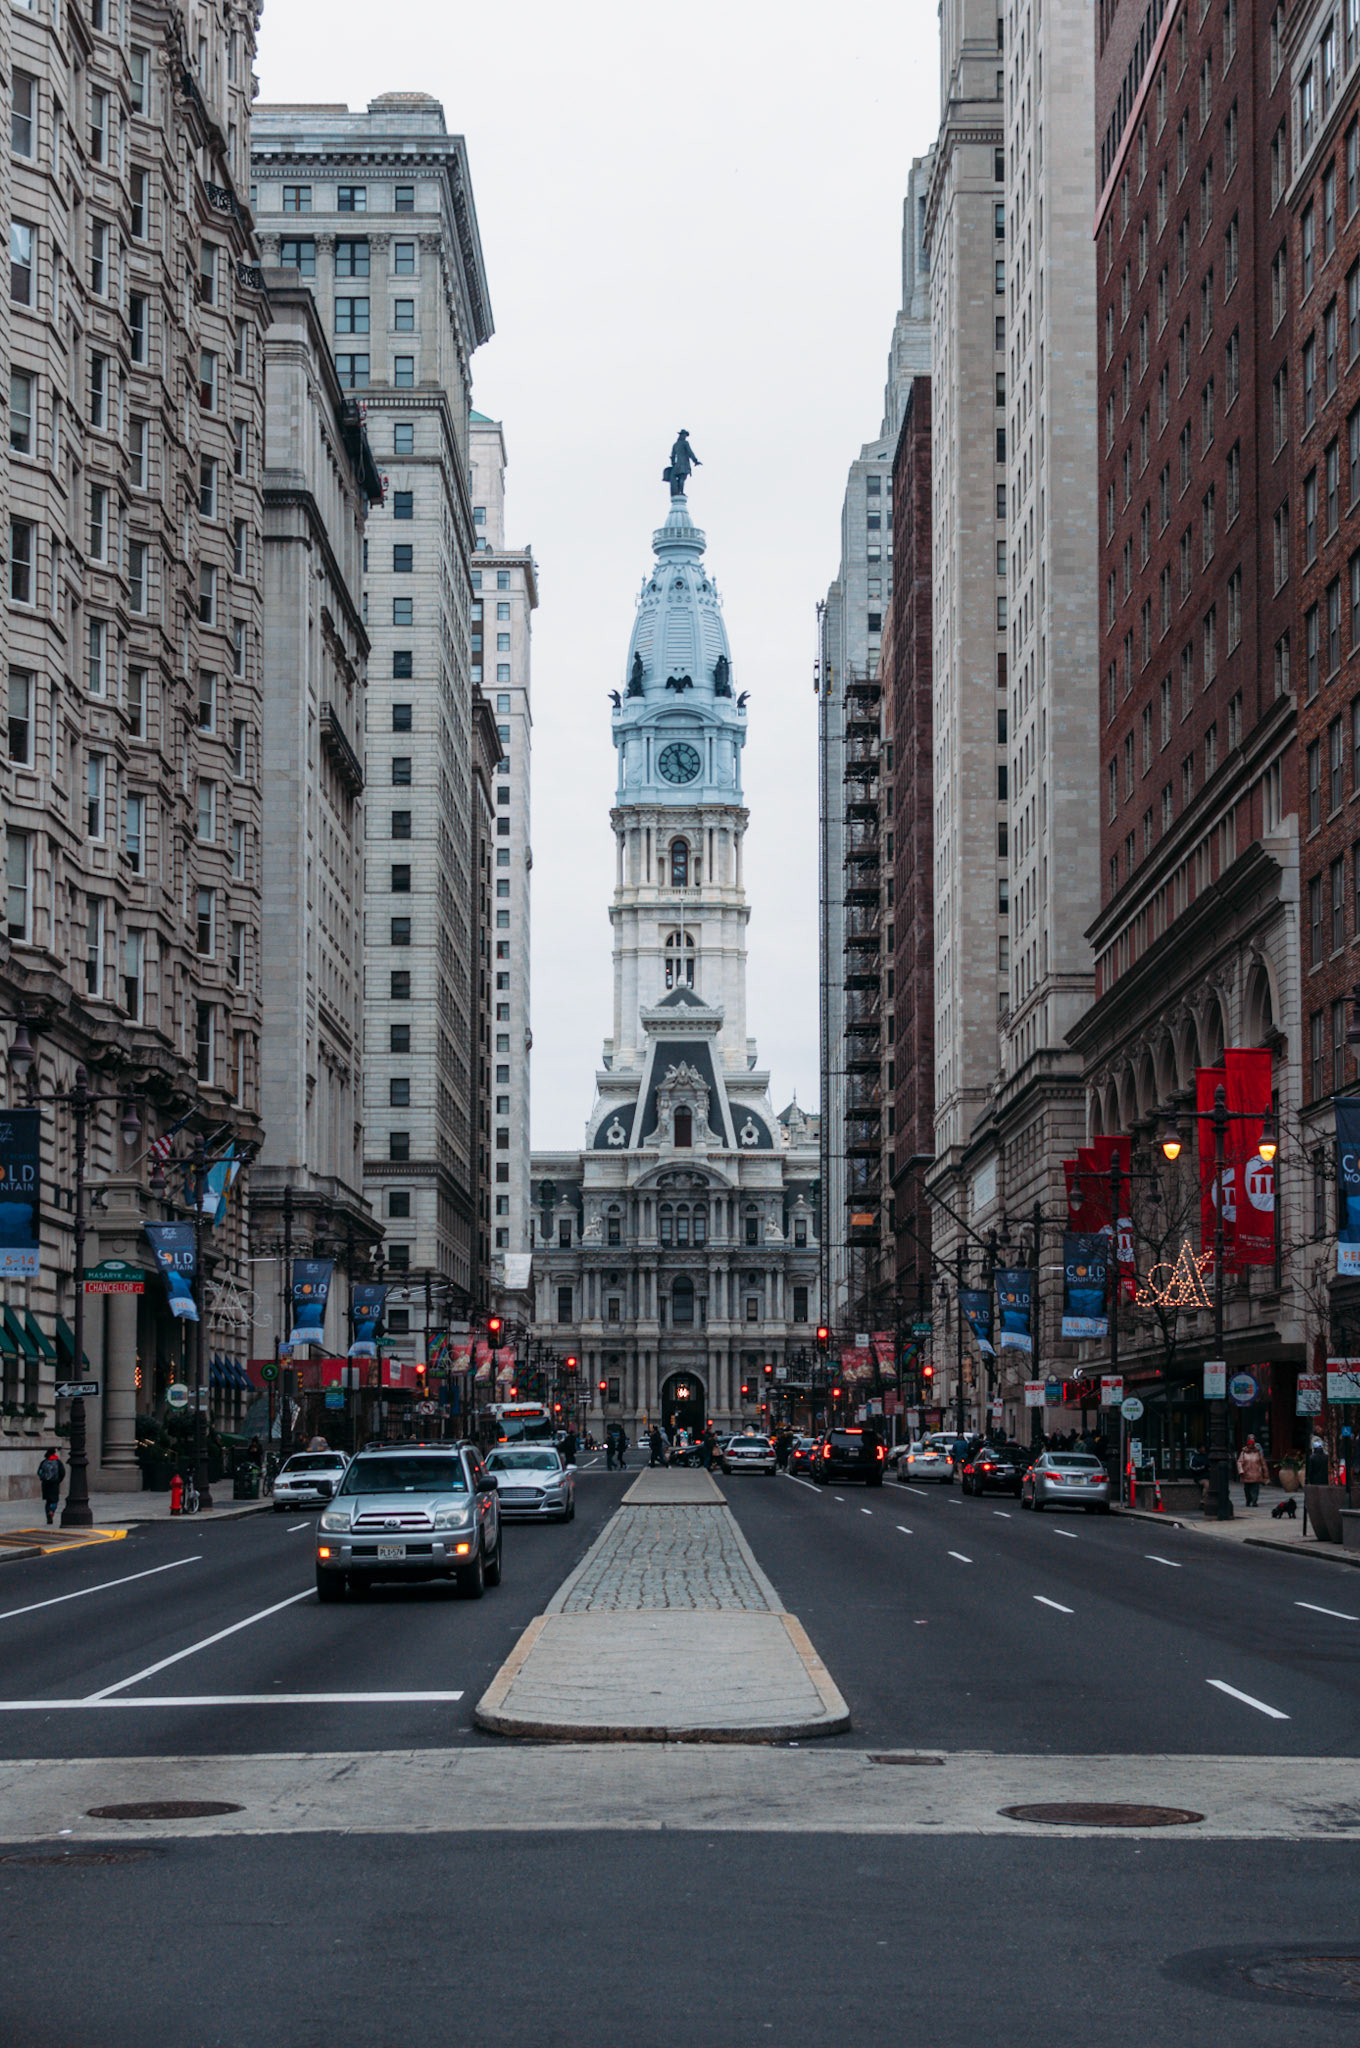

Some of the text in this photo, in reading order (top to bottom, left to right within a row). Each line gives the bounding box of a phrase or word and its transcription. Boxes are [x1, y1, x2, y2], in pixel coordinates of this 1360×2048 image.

[1066, 1264, 1106, 1277] COLD
[88, 1283, 133, 1292] CHANCELLOR
[293, 1283, 328, 1295] COLD
[1000, 1291, 1030, 1303] COLD
